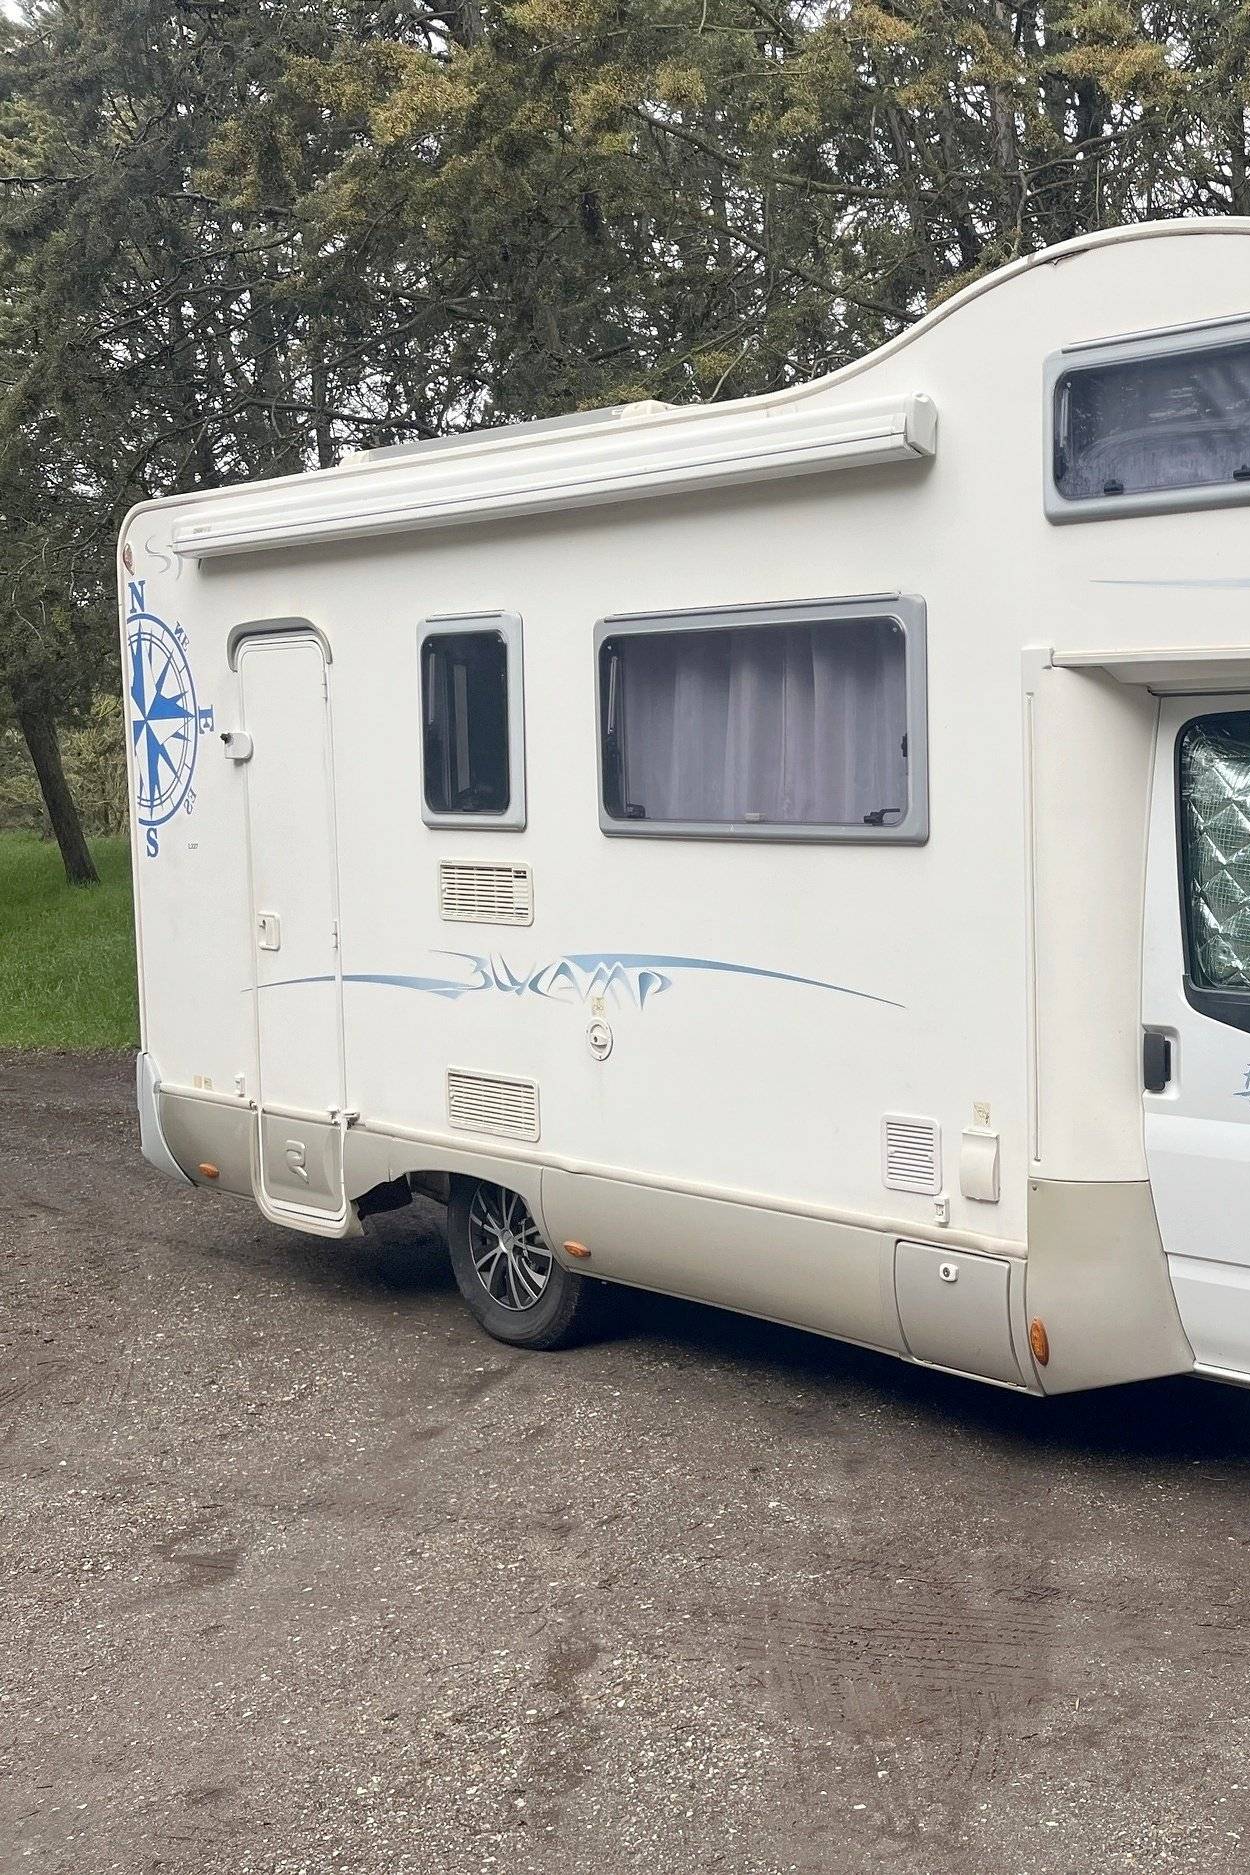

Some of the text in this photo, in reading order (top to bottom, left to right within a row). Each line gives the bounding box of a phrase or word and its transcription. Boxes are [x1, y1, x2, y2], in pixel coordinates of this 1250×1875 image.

[128, 580, 146, 614] N
[198, 705, 215, 735] E
[146, 828, 159, 858] S
